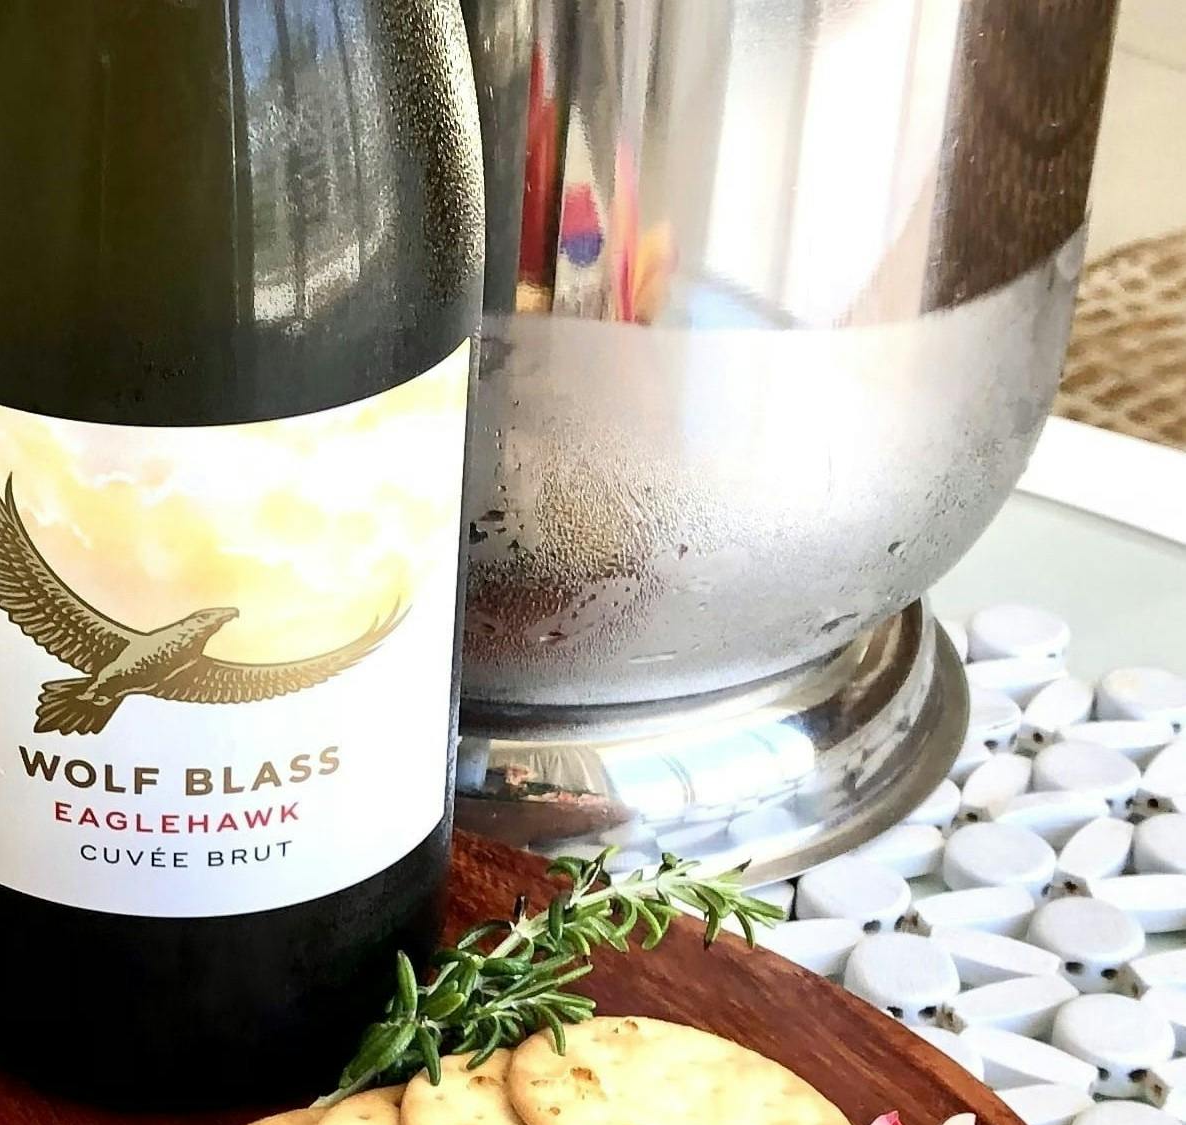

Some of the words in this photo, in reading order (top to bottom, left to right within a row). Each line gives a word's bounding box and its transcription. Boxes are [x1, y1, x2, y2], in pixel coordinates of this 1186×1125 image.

[18, 745, 160, 795] WOLF
[185, 745, 341, 796] BLASS
[55, 801, 300, 834] EAGLEHAWK
[80, 843, 189, 868] CUVÉE
[208, 840, 293, 867] BRUT
